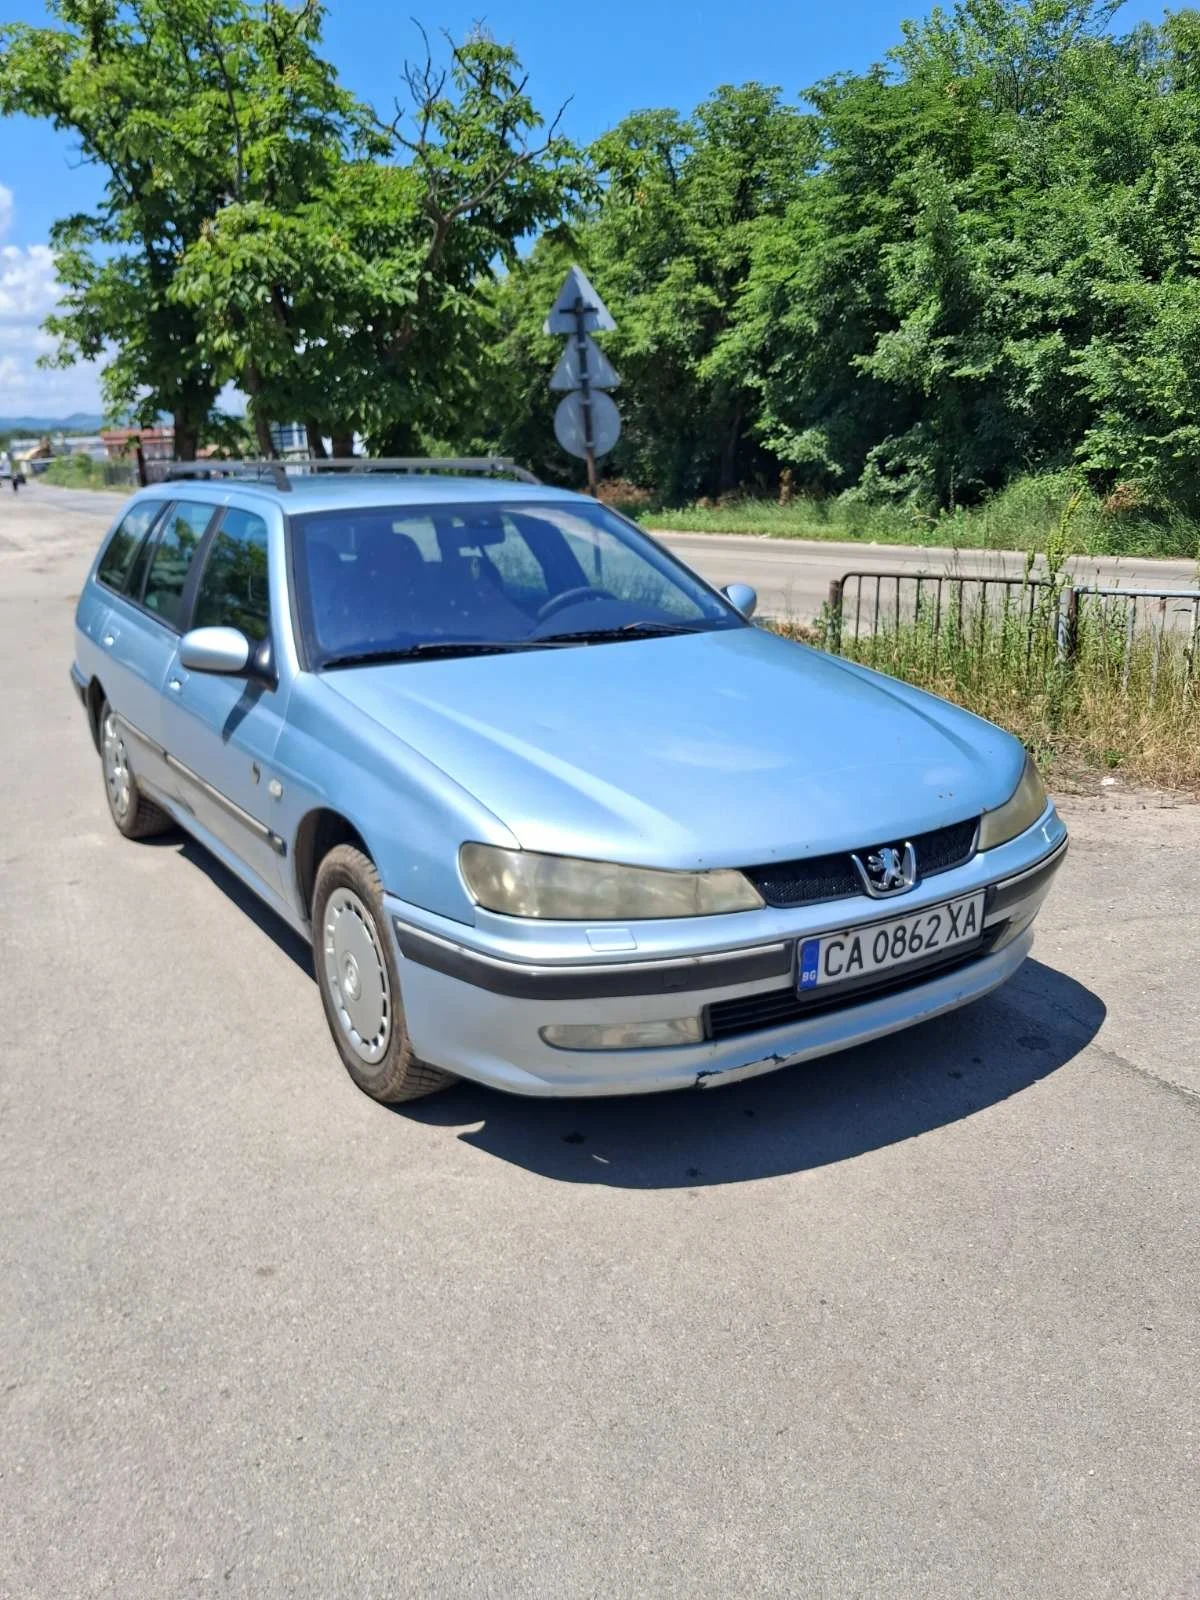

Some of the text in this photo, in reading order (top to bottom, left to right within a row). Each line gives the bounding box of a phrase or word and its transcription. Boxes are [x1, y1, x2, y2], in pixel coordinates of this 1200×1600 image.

[824, 901, 976, 977] CA 0862 XA
[802, 970, 816, 981] BG
